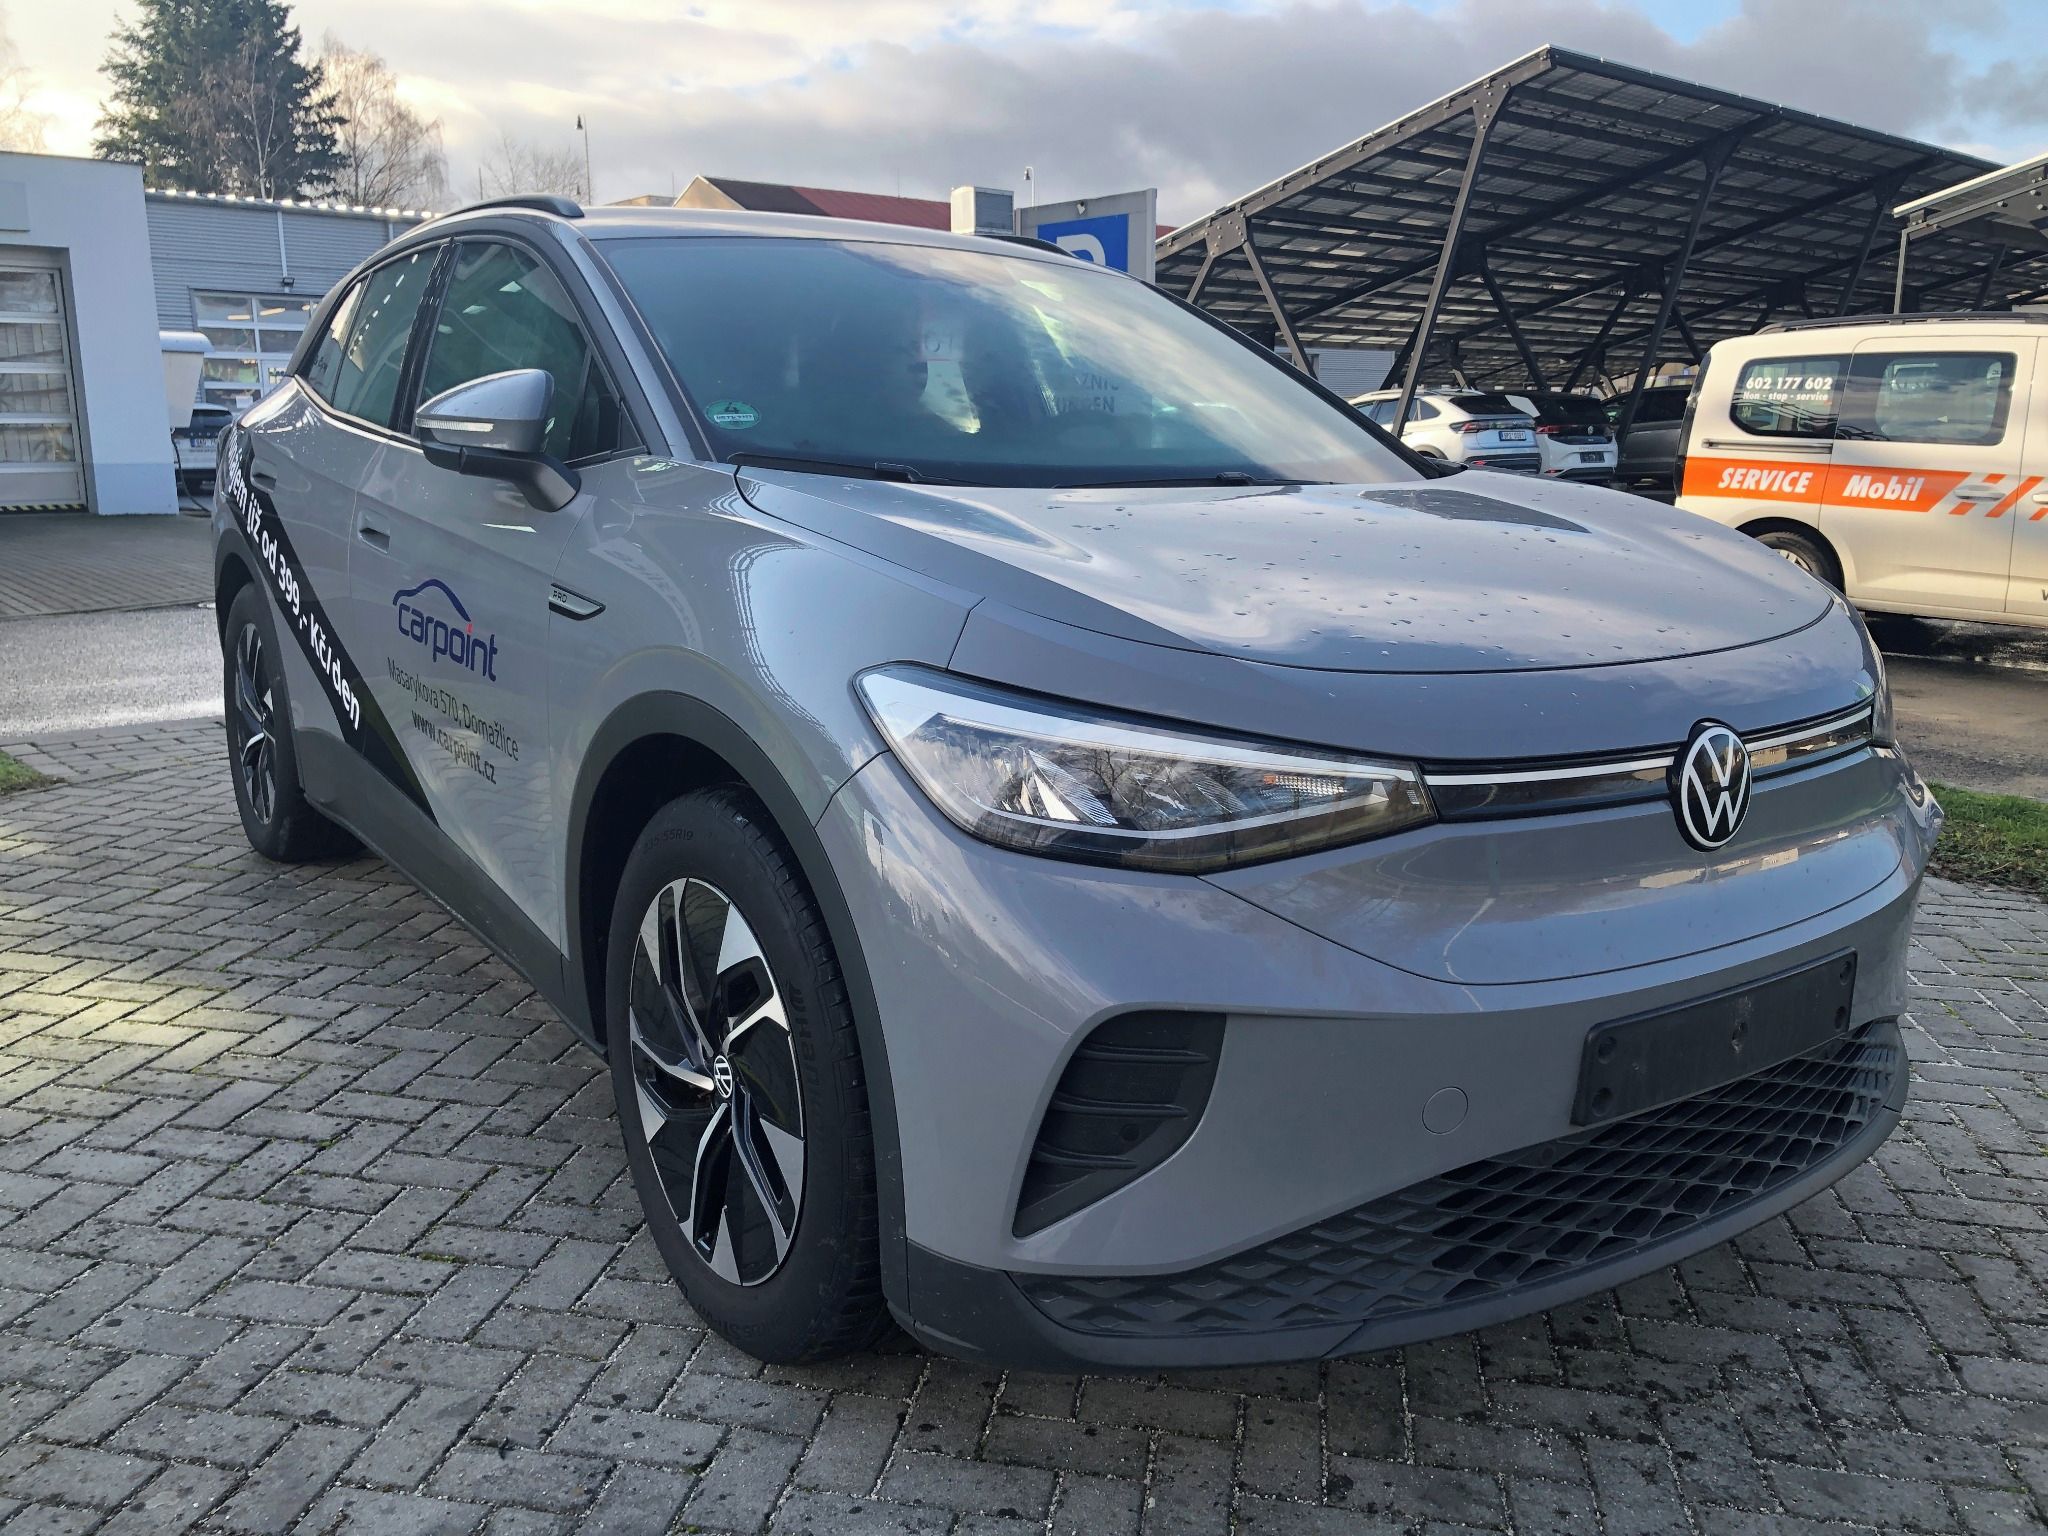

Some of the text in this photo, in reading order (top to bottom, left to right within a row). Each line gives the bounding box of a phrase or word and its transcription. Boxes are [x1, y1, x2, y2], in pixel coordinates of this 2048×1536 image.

[1743, 391, 1760, 401] Non
[1768, 391, 1788, 403] stop
[1796, 391, 1829, 401] service
[1746, 376, 1833, 390] 602 177 602
[1718, 467, 1925, 501] SERVICE Mobil
[246, 491, 263, 544] již
[261, 529, 278, 574] od
[309, 612, 360, 731] Kč/den
[553, 590, 568, 603] PRO
[398, 602, 498, 682] carpoint
[387, 656, 519, 762] Masarykova 570, Domažlice
[411, 709, 497, 785] www.carpoint.cz
